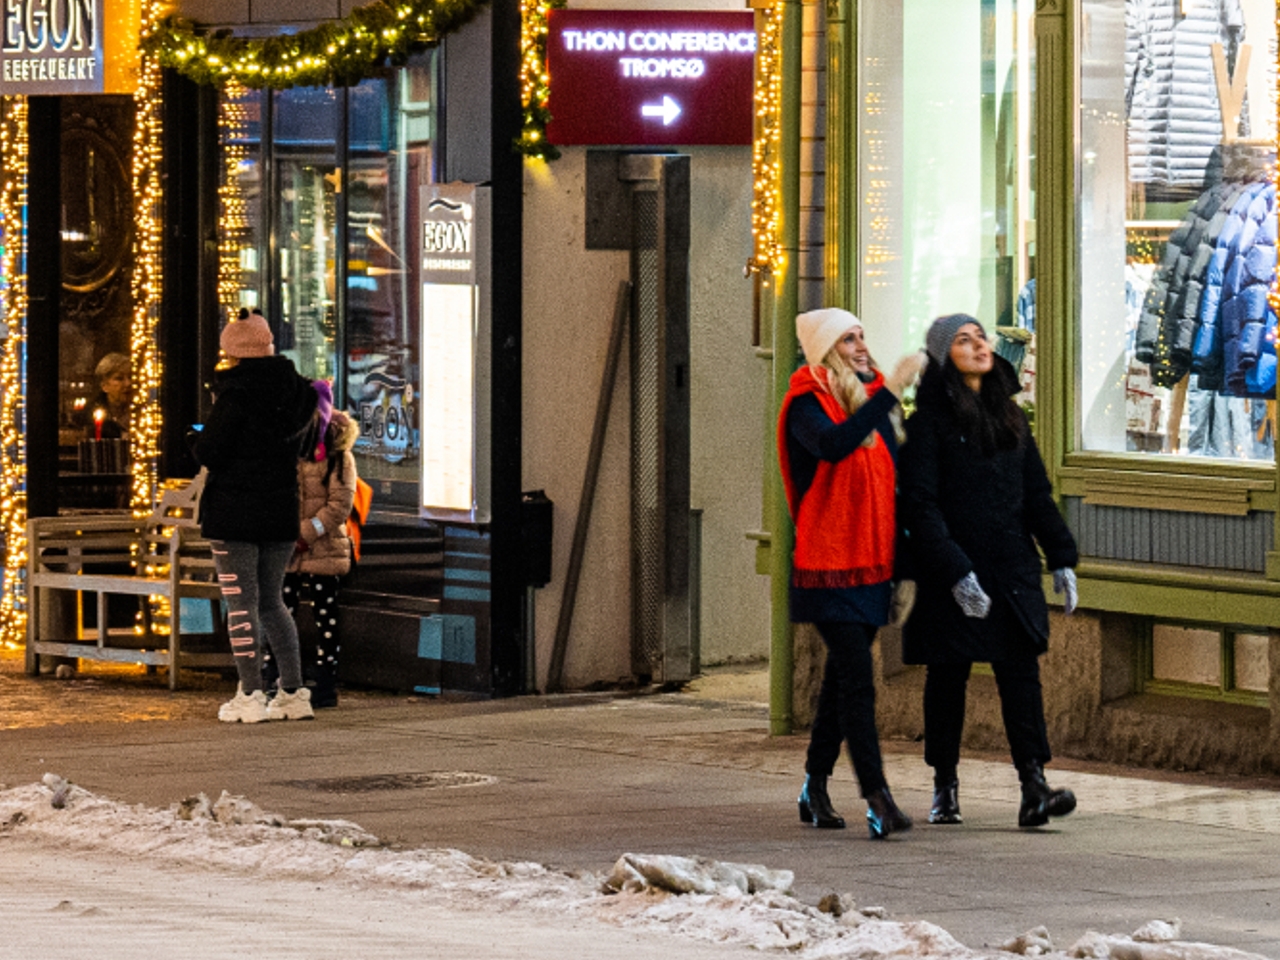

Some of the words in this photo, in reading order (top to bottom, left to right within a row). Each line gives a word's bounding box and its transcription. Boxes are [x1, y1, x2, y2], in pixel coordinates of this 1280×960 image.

[562, 31, 625, 51] THON
[628, 31, 757, 52] CONFERENCE
[4, 57, 96, 82] RESTAURANT
[619, 58, 704, 77] TROMSØ
[423, 219, 472, 254] EGON
